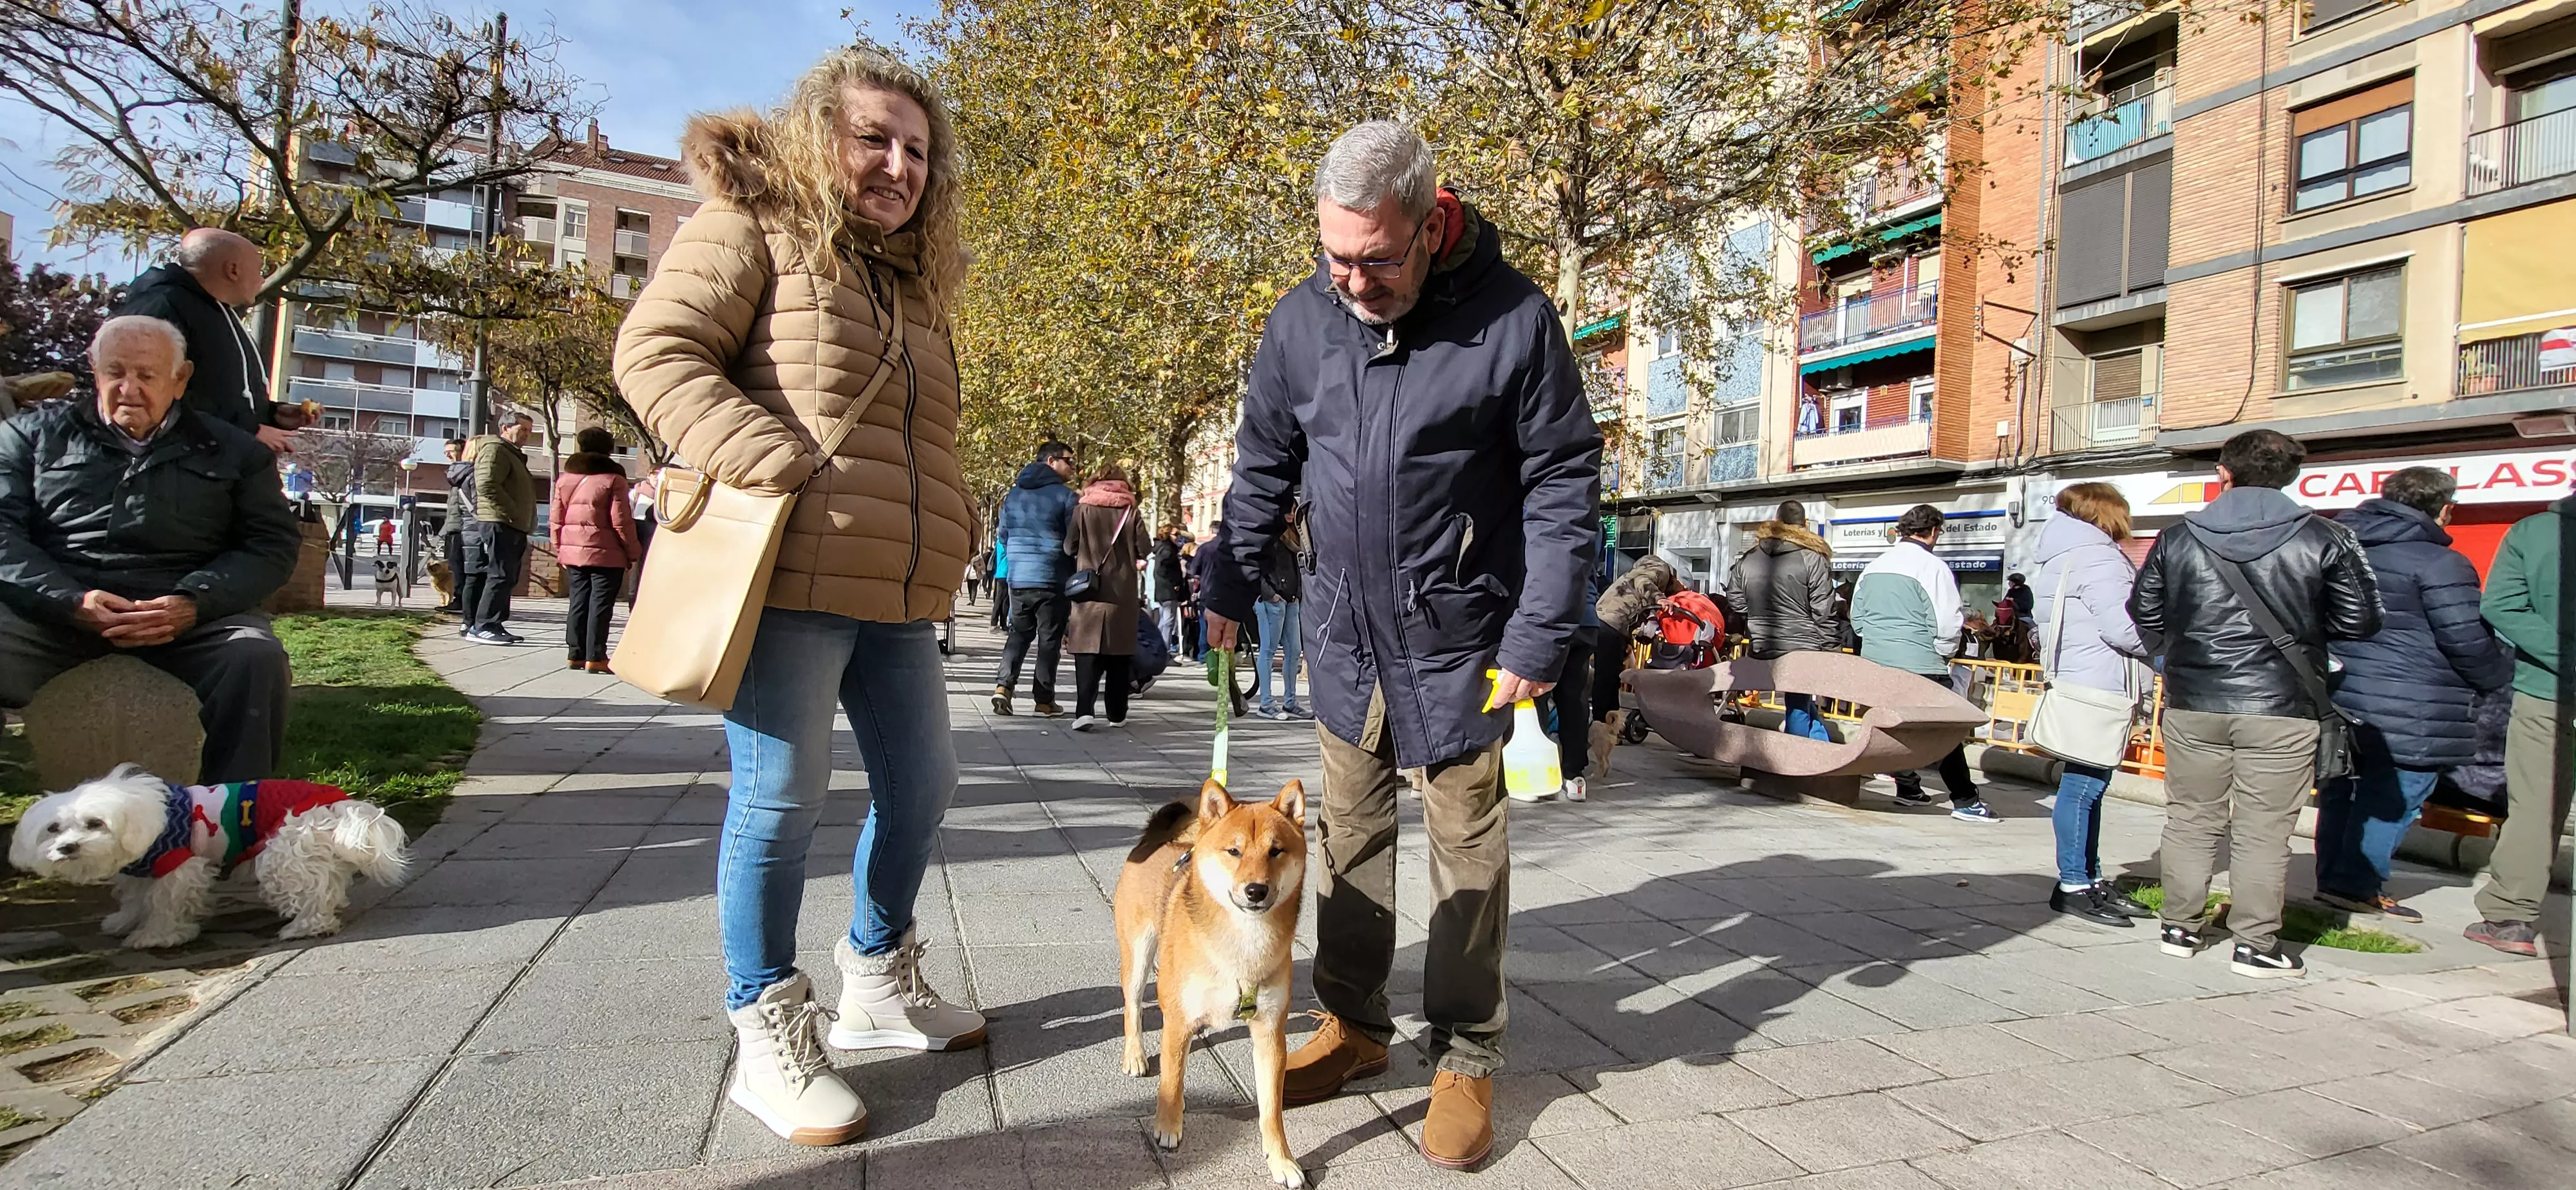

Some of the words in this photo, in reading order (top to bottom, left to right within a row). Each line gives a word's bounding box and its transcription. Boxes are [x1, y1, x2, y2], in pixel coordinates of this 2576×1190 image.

[2298, 459, 2576, 497] CALAS
[1843, 528, 1875, 536] Loterías
[1946, 524, 1960, 533] del
[1963, 522, 1997, 532] Estado
